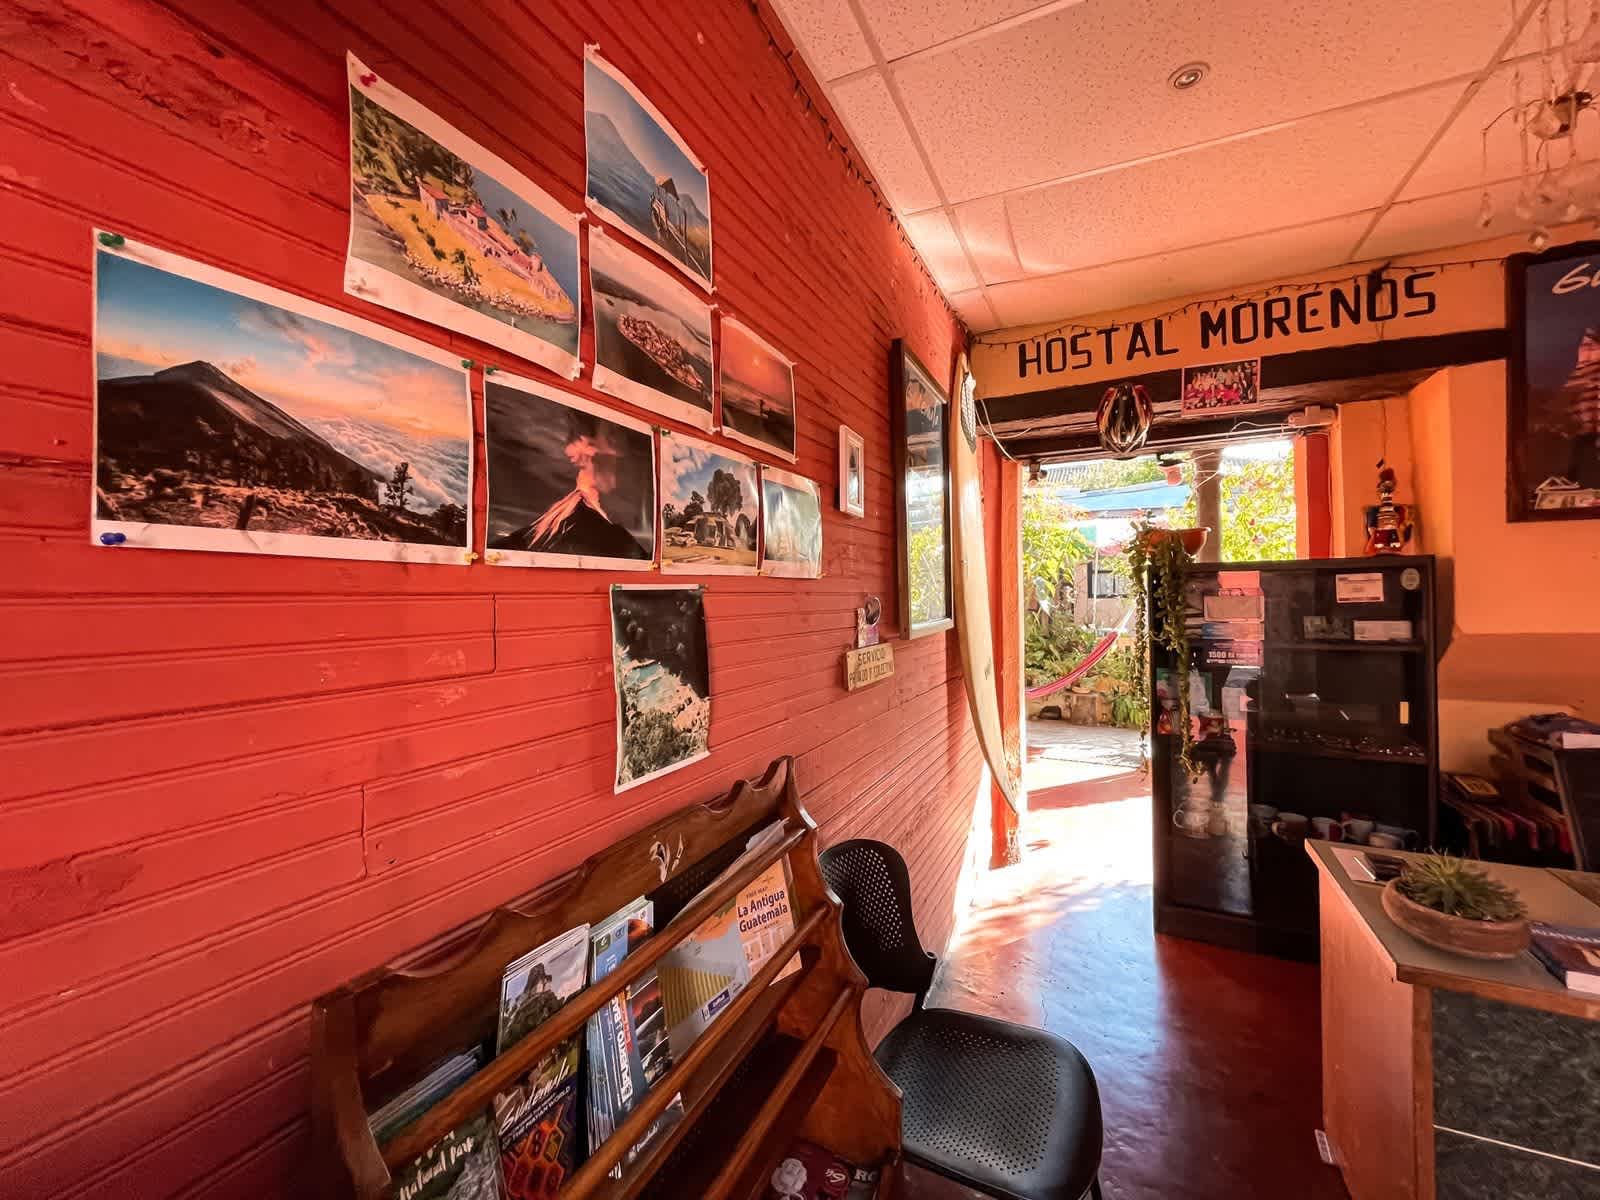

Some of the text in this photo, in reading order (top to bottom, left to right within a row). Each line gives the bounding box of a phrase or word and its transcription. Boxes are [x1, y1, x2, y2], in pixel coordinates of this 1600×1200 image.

[1018, 271, 1437, 378] HOSTAL MORENOS
[737, 889, 785, 918] La Antigua
[739, 903, 788, 933] Guatemala
